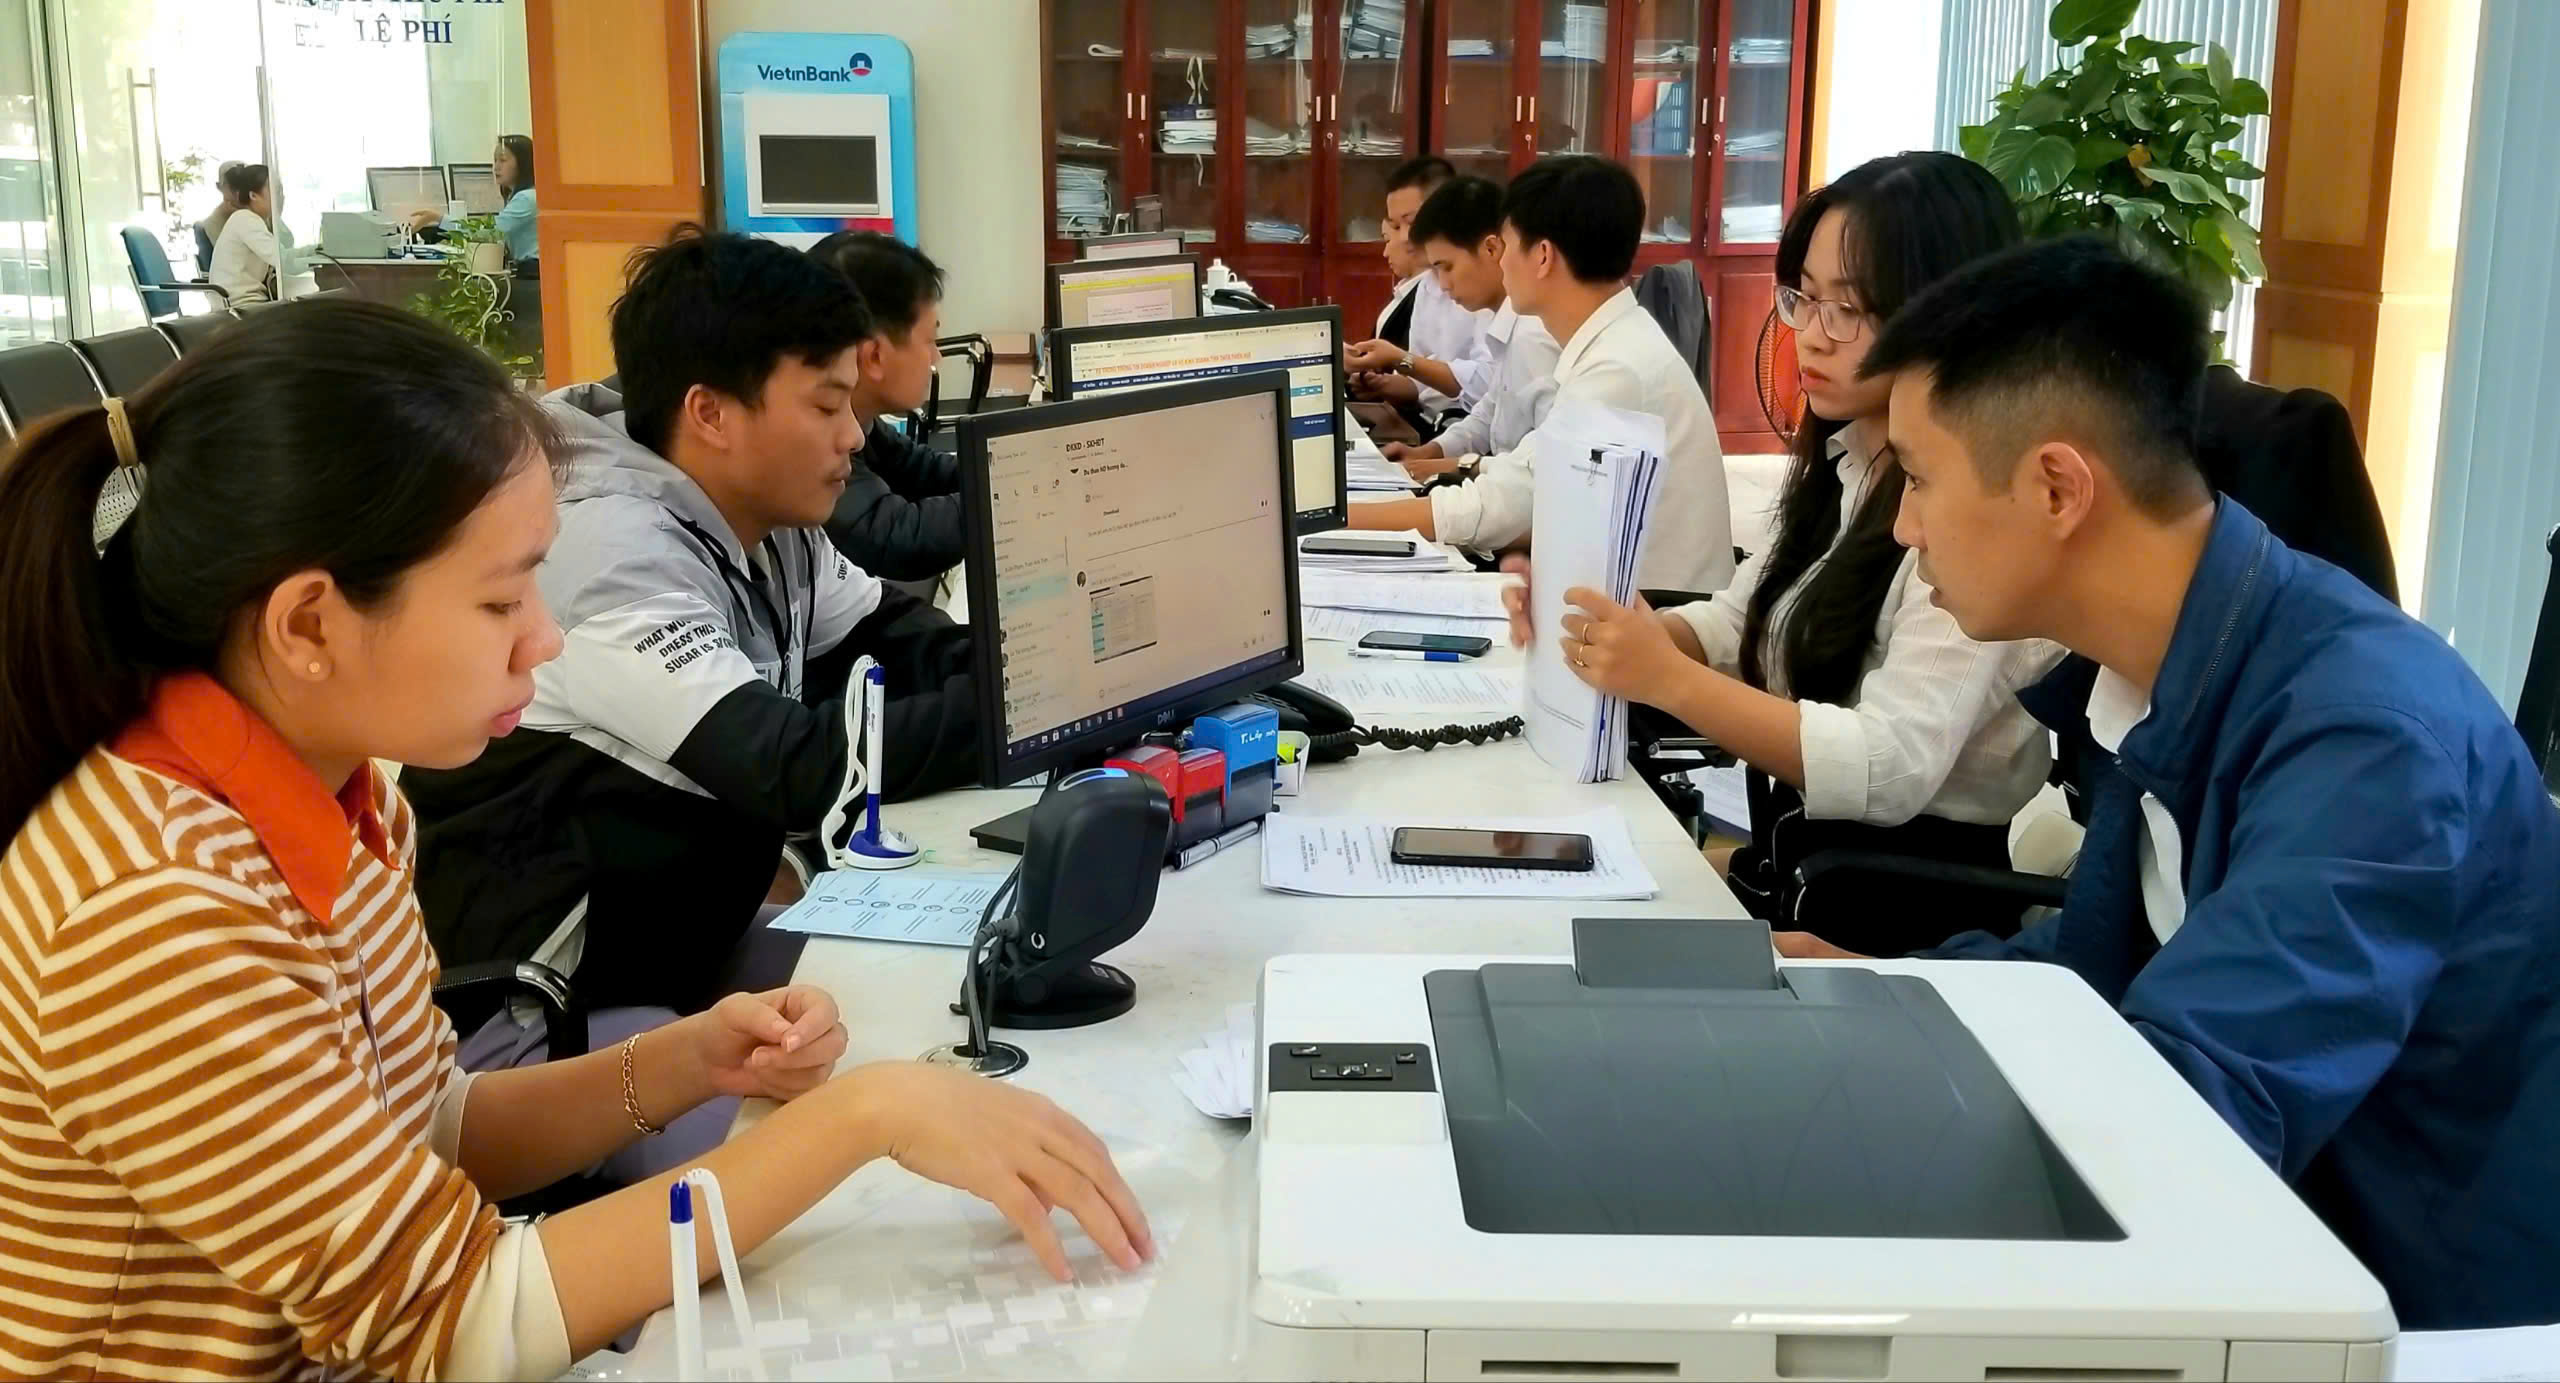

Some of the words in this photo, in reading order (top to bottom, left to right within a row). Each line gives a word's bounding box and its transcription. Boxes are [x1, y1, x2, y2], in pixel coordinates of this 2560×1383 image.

[402, 13, 453, 44] PHÍ
[757, 64, 851, 82] VietinBank
[633, 628, 666, 654] WHAT
[658, 631, 694, 658] DRESS
[692, 623, 717, 639] THIS
[664, 647, 703, 674] SUGAR
[700, 642, 714, 654] IS
